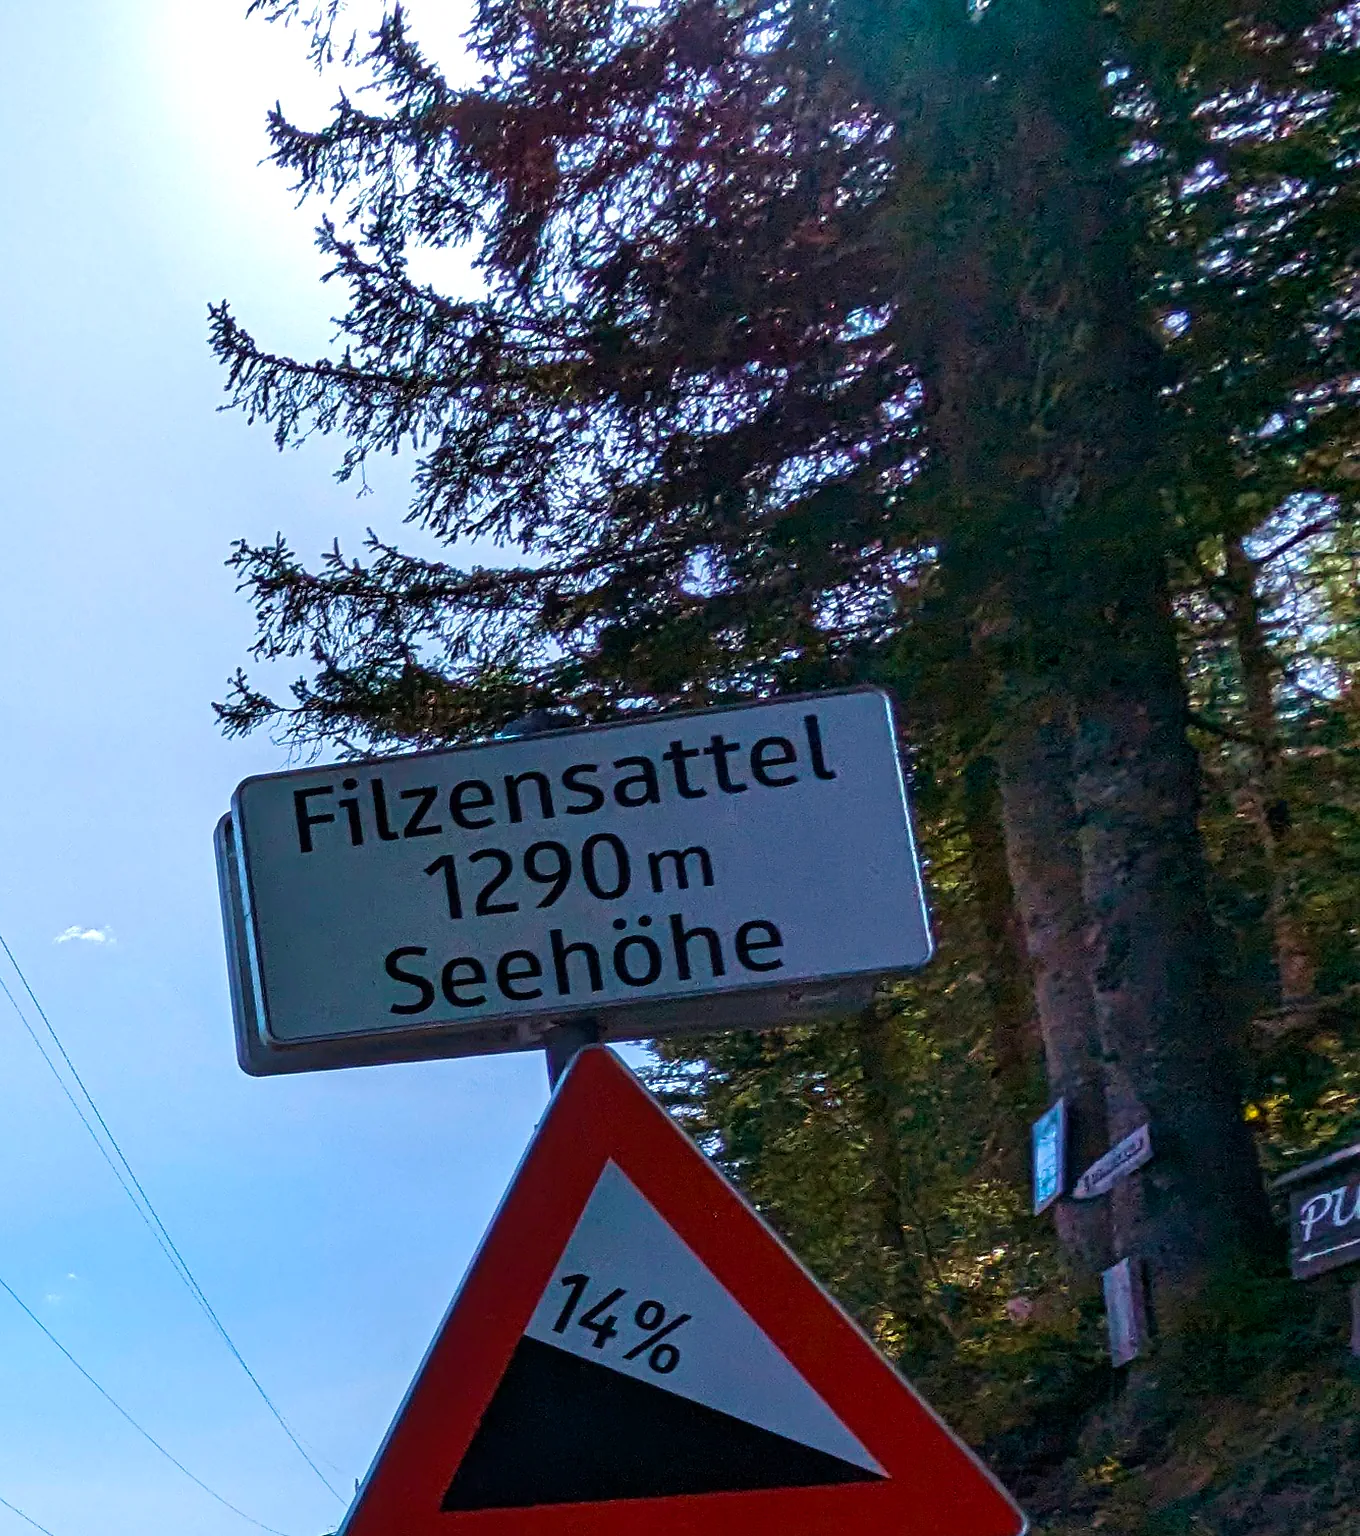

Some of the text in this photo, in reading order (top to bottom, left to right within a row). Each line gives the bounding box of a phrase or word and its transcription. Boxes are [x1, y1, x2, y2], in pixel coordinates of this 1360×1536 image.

[293, 714, 836, 854] Filzensattel
[423, 832, 717, 921] 1290 m
[384, 912, 786, 1015] Seehöhe
[551, 1273, 693, 1375] 14%
